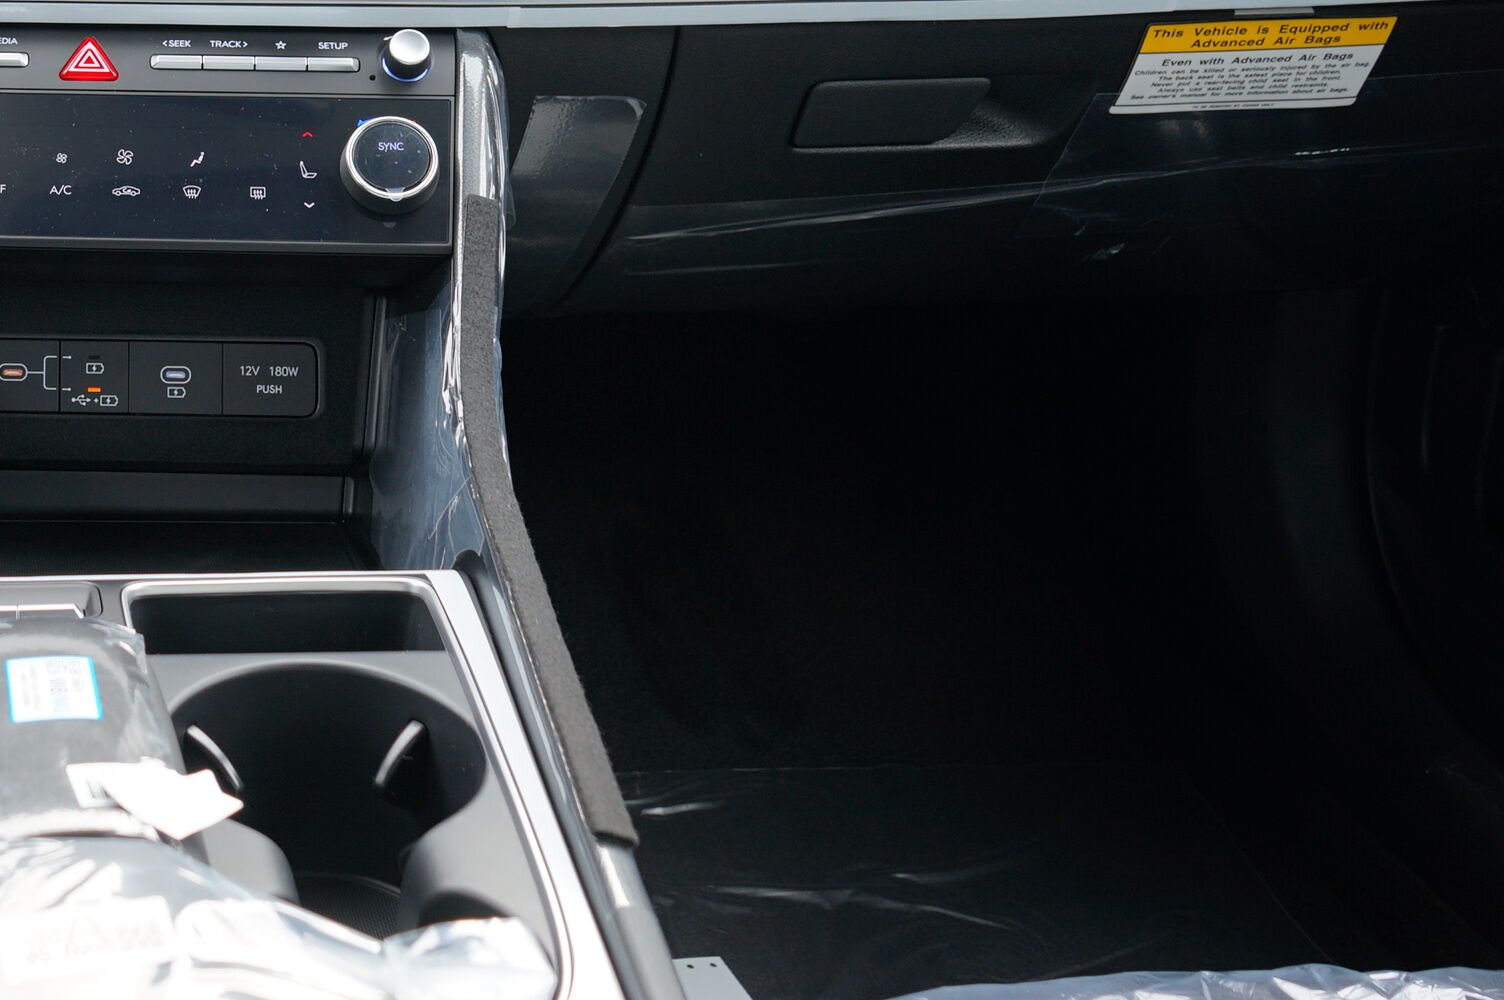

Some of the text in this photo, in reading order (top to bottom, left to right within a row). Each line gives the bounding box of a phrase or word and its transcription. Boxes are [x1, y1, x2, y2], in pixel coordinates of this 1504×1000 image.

[1153, 21, 1389, 38] This Vehicle is Equipped with
[318, 41, 348, 50] SETUP
[1190, 35, 1342, 48] Advanced Air Bags
[1161, 59, 1192, 67] Even
[1199, 57, 1225, 65] with
[1231, 55, 1293, 65] Advanced
[1323, 52, 1354, 62] Bags
[378, 142, 404, 151] SYNC
[49, 184, 72, 195] A/C
[239, 366, 299, 377] 12V 180W
[256, 385, 283, 394] PUSH
